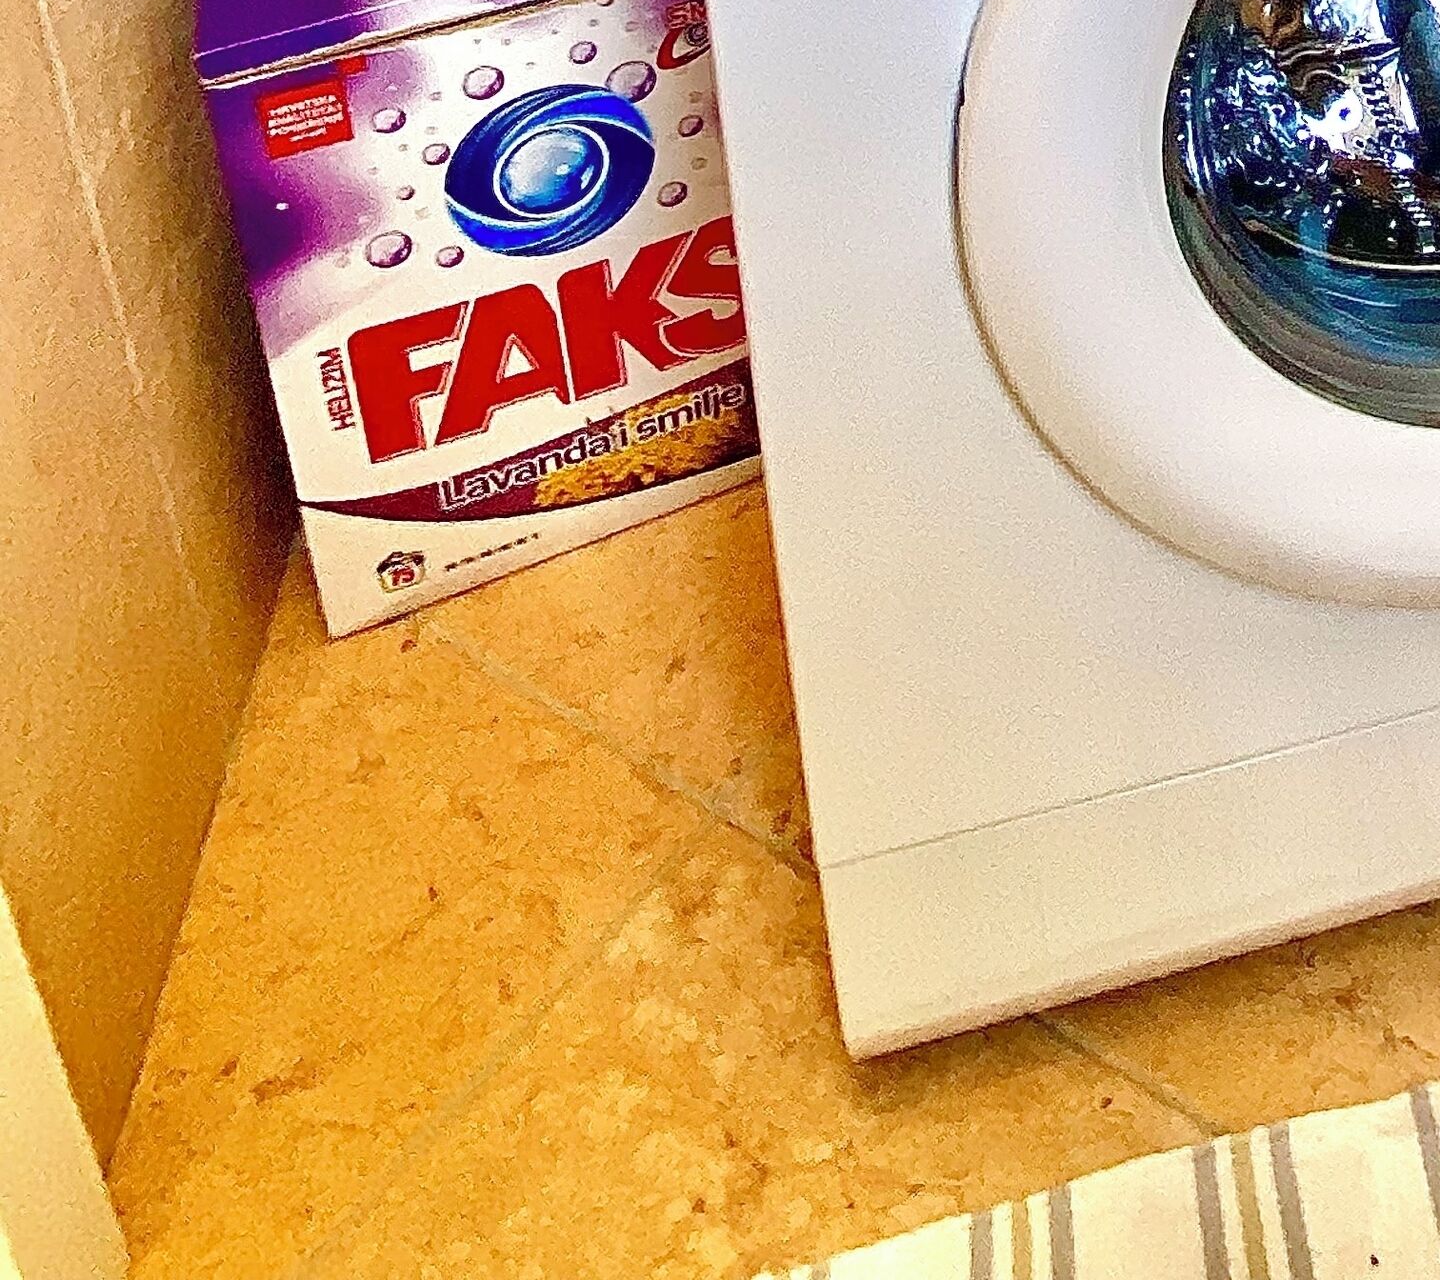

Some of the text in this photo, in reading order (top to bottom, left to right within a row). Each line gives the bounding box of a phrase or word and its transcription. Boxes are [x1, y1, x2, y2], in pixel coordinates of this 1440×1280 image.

[347, 215, 747, 464] FAKS
[435, 432, 612, 513] Lavanda
[635, 379, 748, 439] smilje
